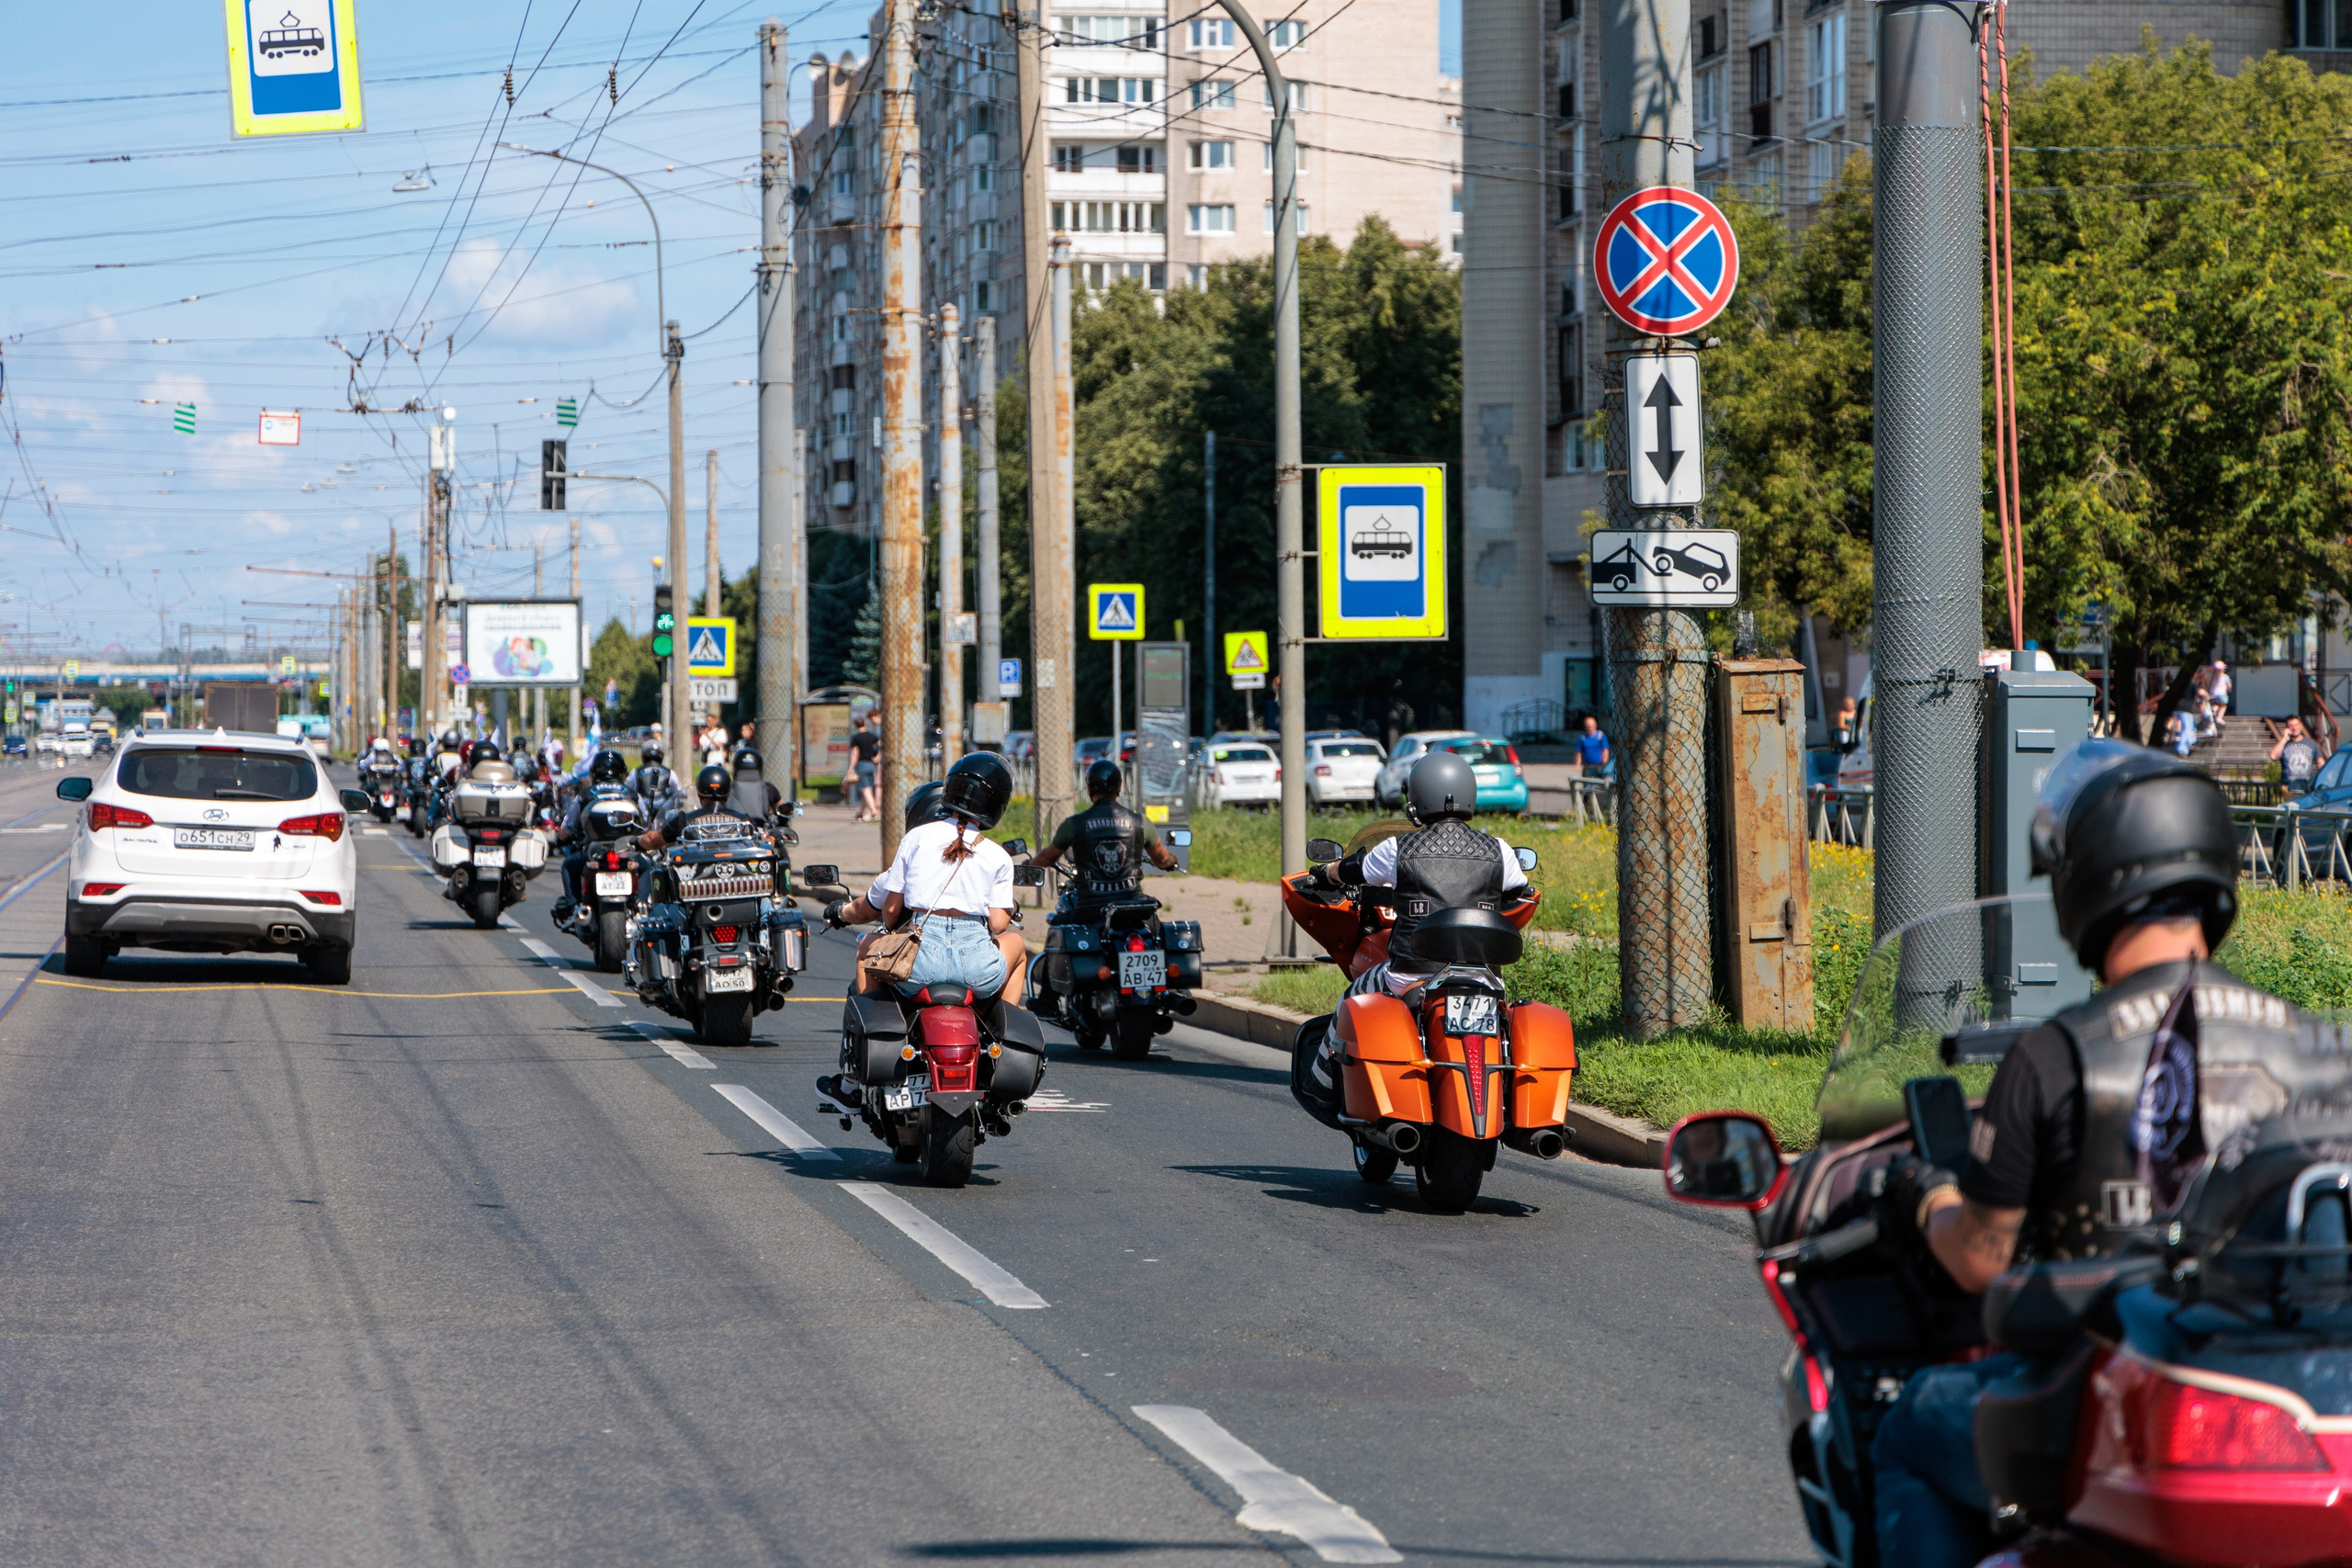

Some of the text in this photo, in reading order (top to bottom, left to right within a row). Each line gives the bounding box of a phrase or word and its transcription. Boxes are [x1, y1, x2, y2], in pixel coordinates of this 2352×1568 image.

[689, 682, 727, 695] ТОП
[237, 831, 250, 841] 29
[1126, 954, 1158, 967] 2709
[732, 979, 745, 987] 50
[1148, 972, 1161, 983] 47
[1453, 997, 1491, 1010] 3471
[1476, 1018, 1495, 1031] 78
